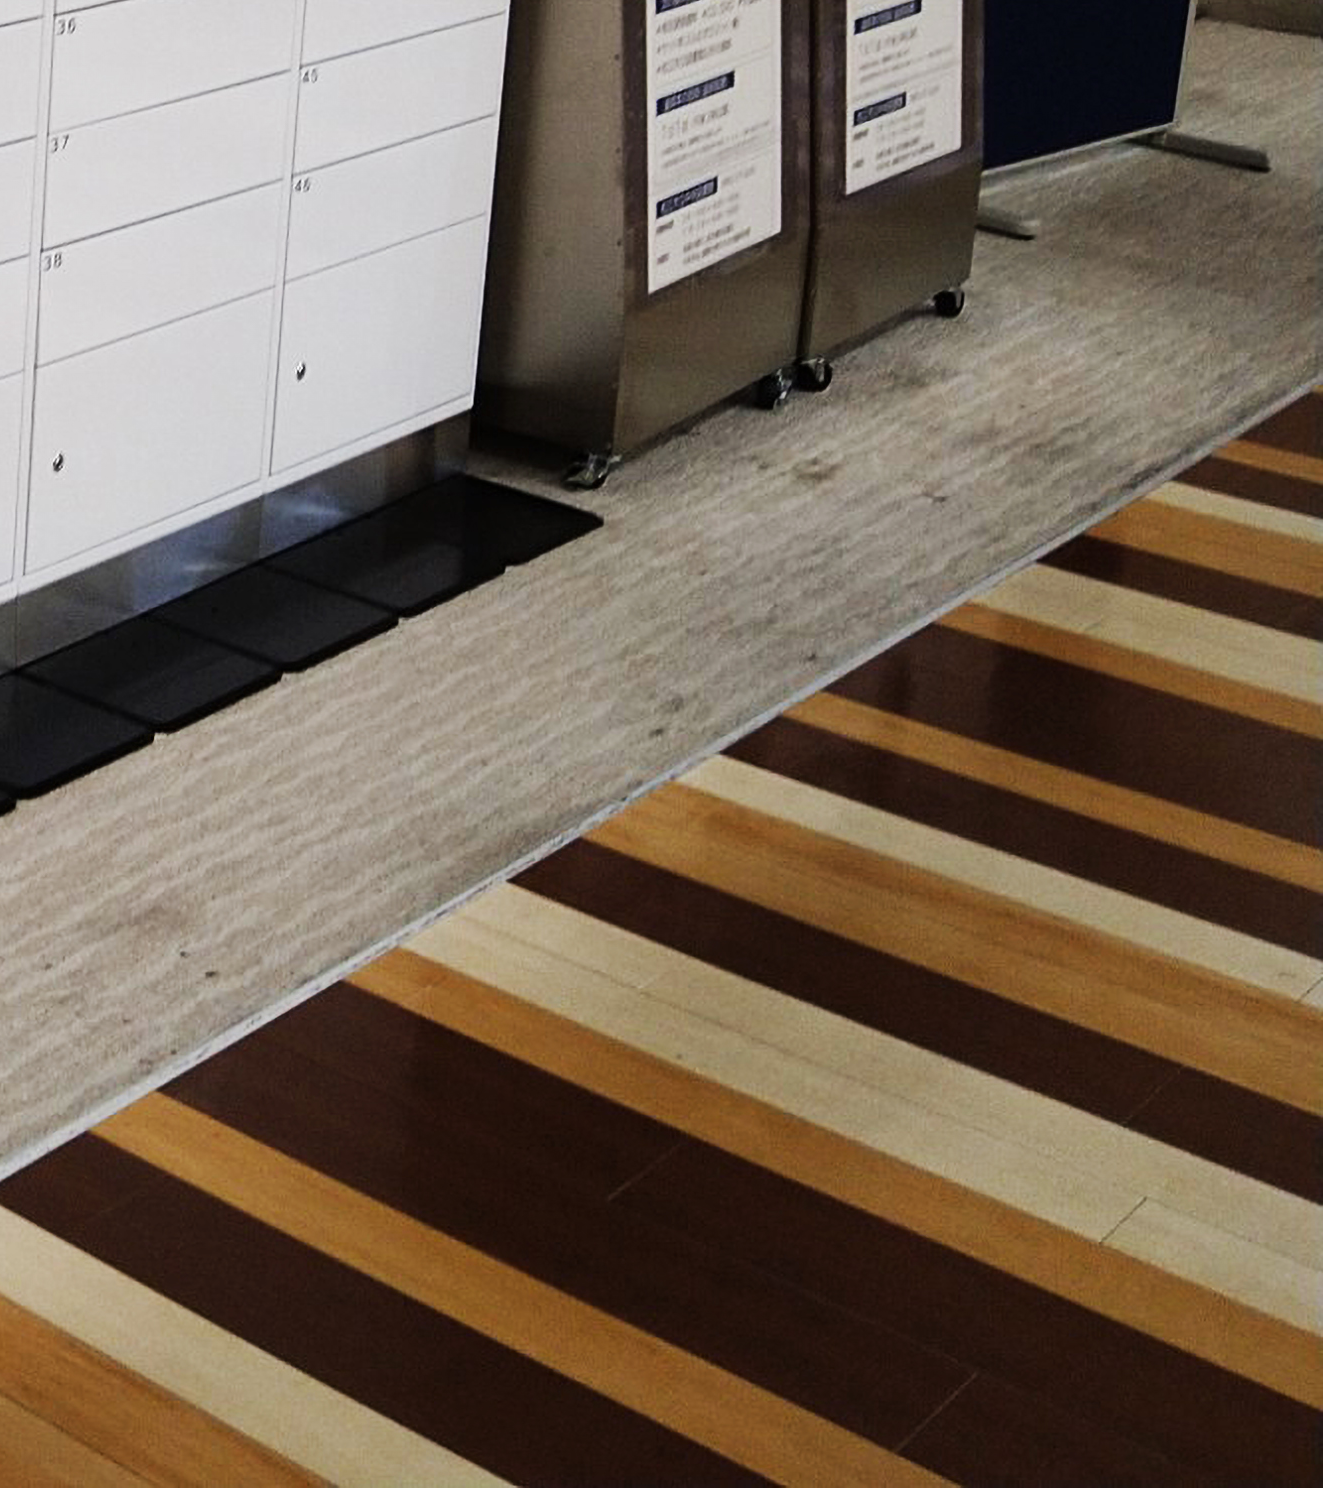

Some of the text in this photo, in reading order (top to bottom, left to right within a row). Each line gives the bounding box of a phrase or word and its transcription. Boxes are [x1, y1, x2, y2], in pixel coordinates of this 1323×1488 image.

[58, 17, 76, 34] 36
[52, 135, 69, 153] 37
[43, 253, 62, 270] 38
